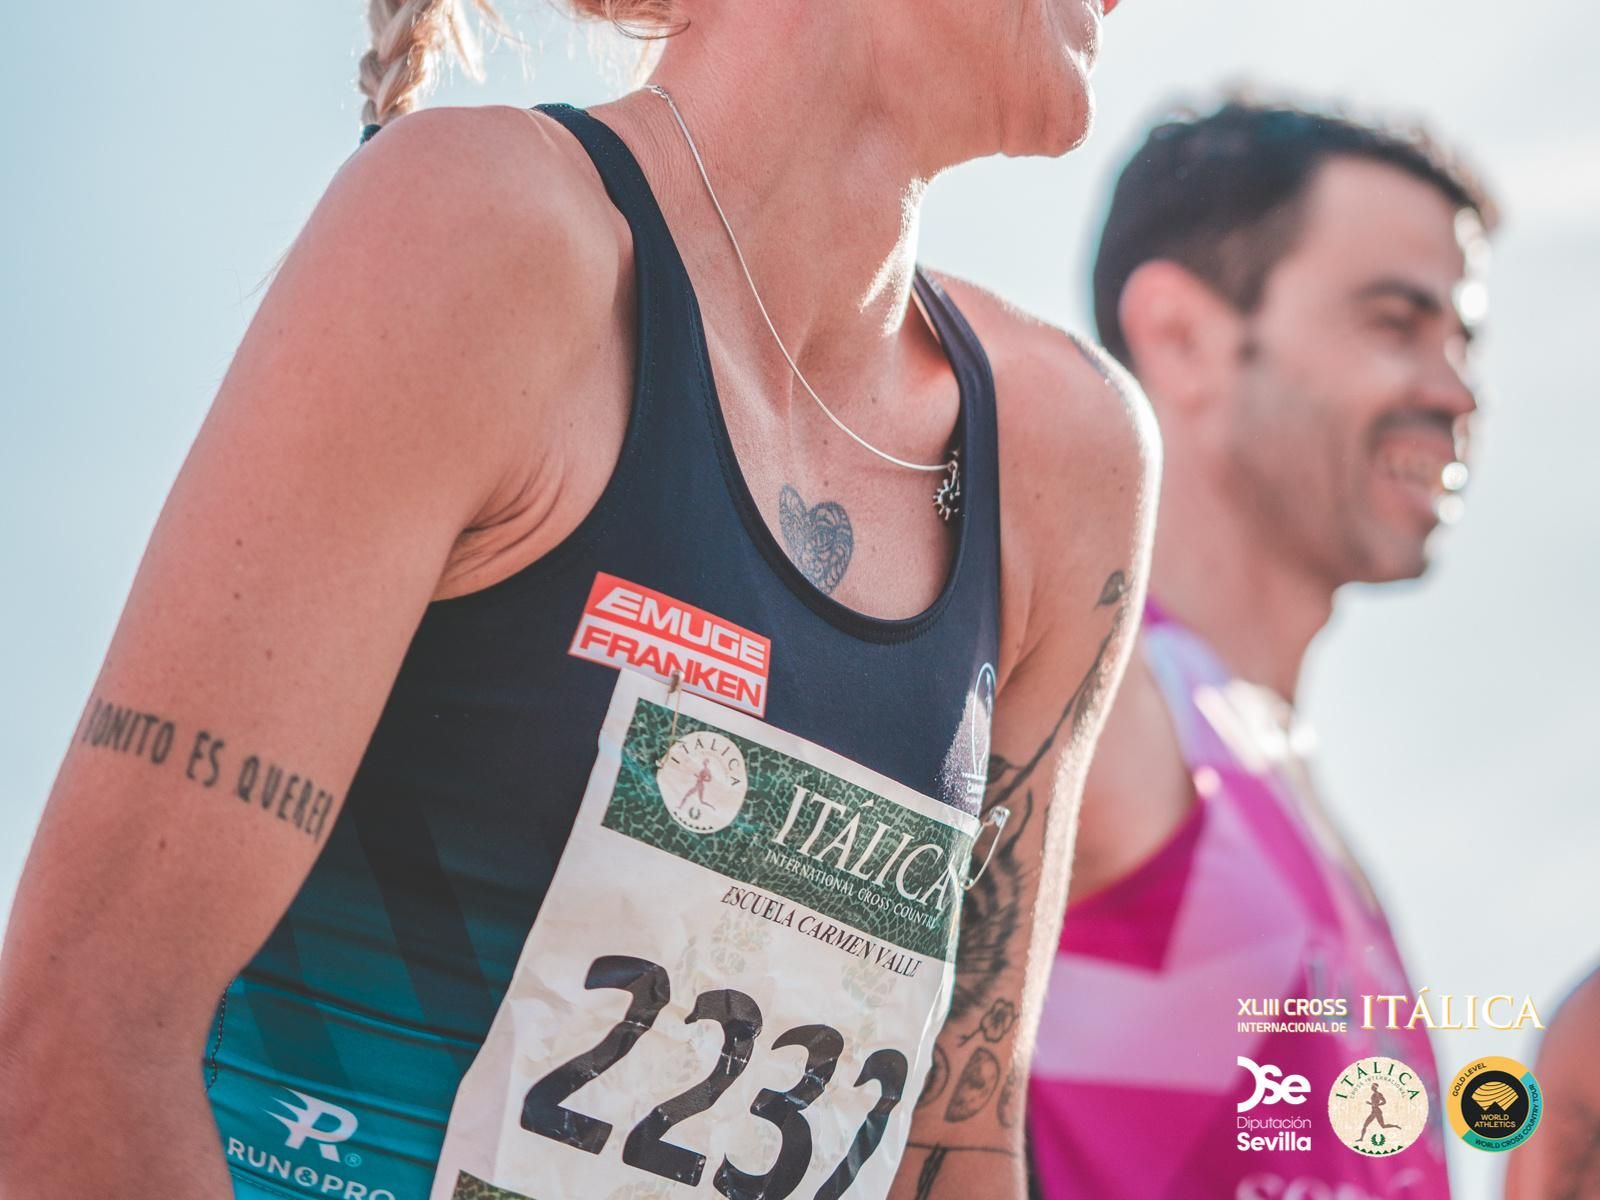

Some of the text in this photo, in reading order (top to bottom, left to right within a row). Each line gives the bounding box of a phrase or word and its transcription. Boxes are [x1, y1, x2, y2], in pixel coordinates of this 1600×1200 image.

[580, 625, 761, 707] FRANKEN
[595, 587, 765, 670] EMUGE
[186, 730, 225, 787] ES
[765, 849, 853, 896] INTERNATIONAL
[857, 887, 894, 913] CROSS
[772, 784, 952, 912] ITÁLICA
[720, 885, 797, 928] ESCUELA
[797, 915, 876, 960] CARMEN
